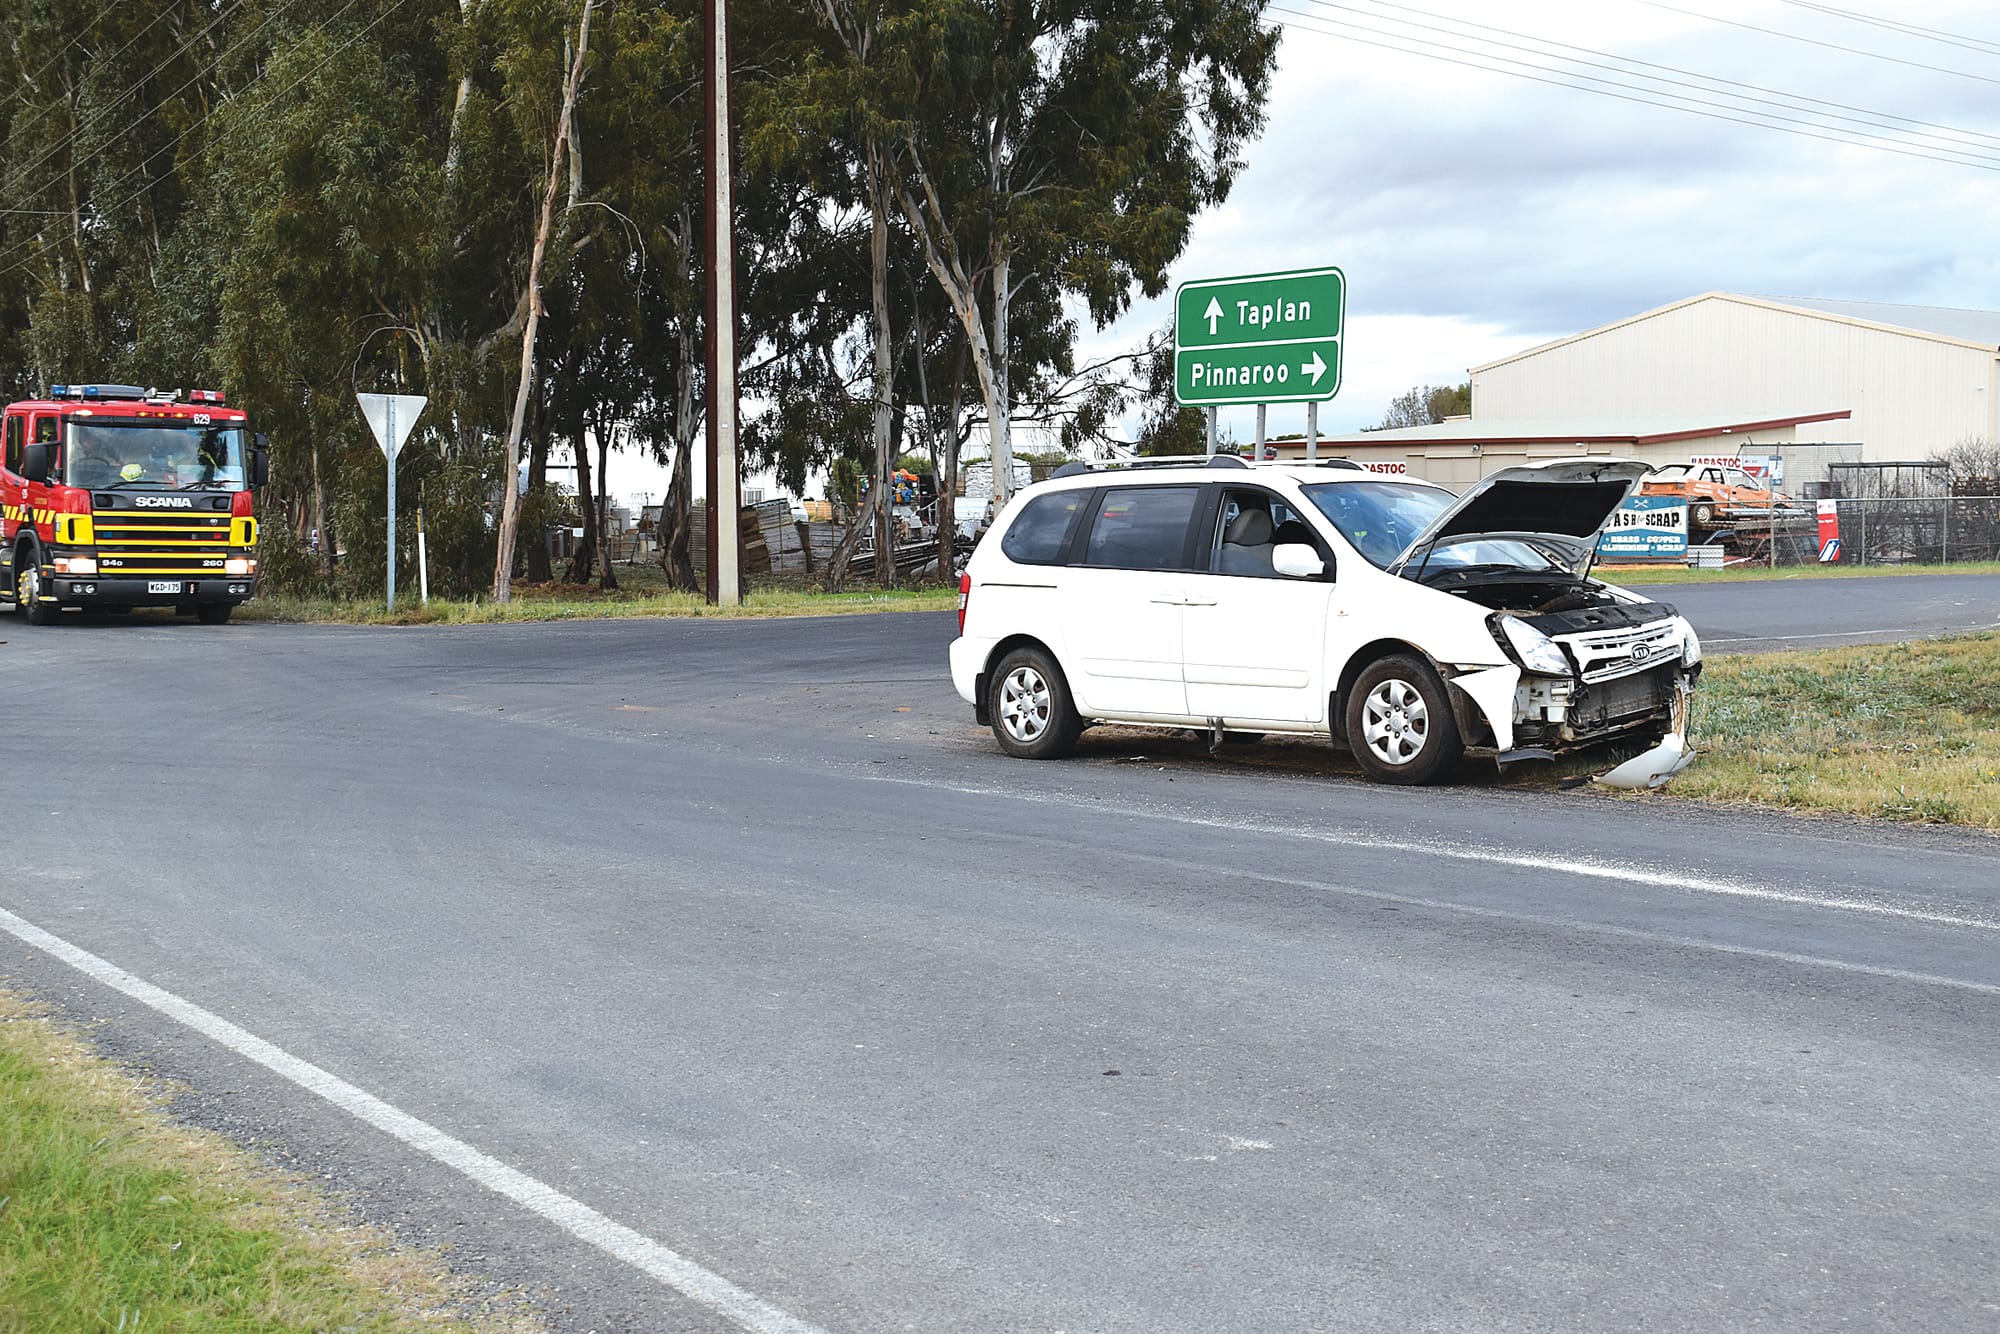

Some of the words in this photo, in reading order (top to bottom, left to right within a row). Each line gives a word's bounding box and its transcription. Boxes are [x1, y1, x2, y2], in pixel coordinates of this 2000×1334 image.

[1237, 297, 1310, 330] Taplan
[1192, 362, 1288, 387] Pinnaroo
[193, 413, 210, 424] 629
[136, 497, 192, 507] SCANIA
[1606, 513, 1636, 527] ASH
[1645, 512, 1680, 527] SCRAP
[1633, 649, 1650, 660] KIA
